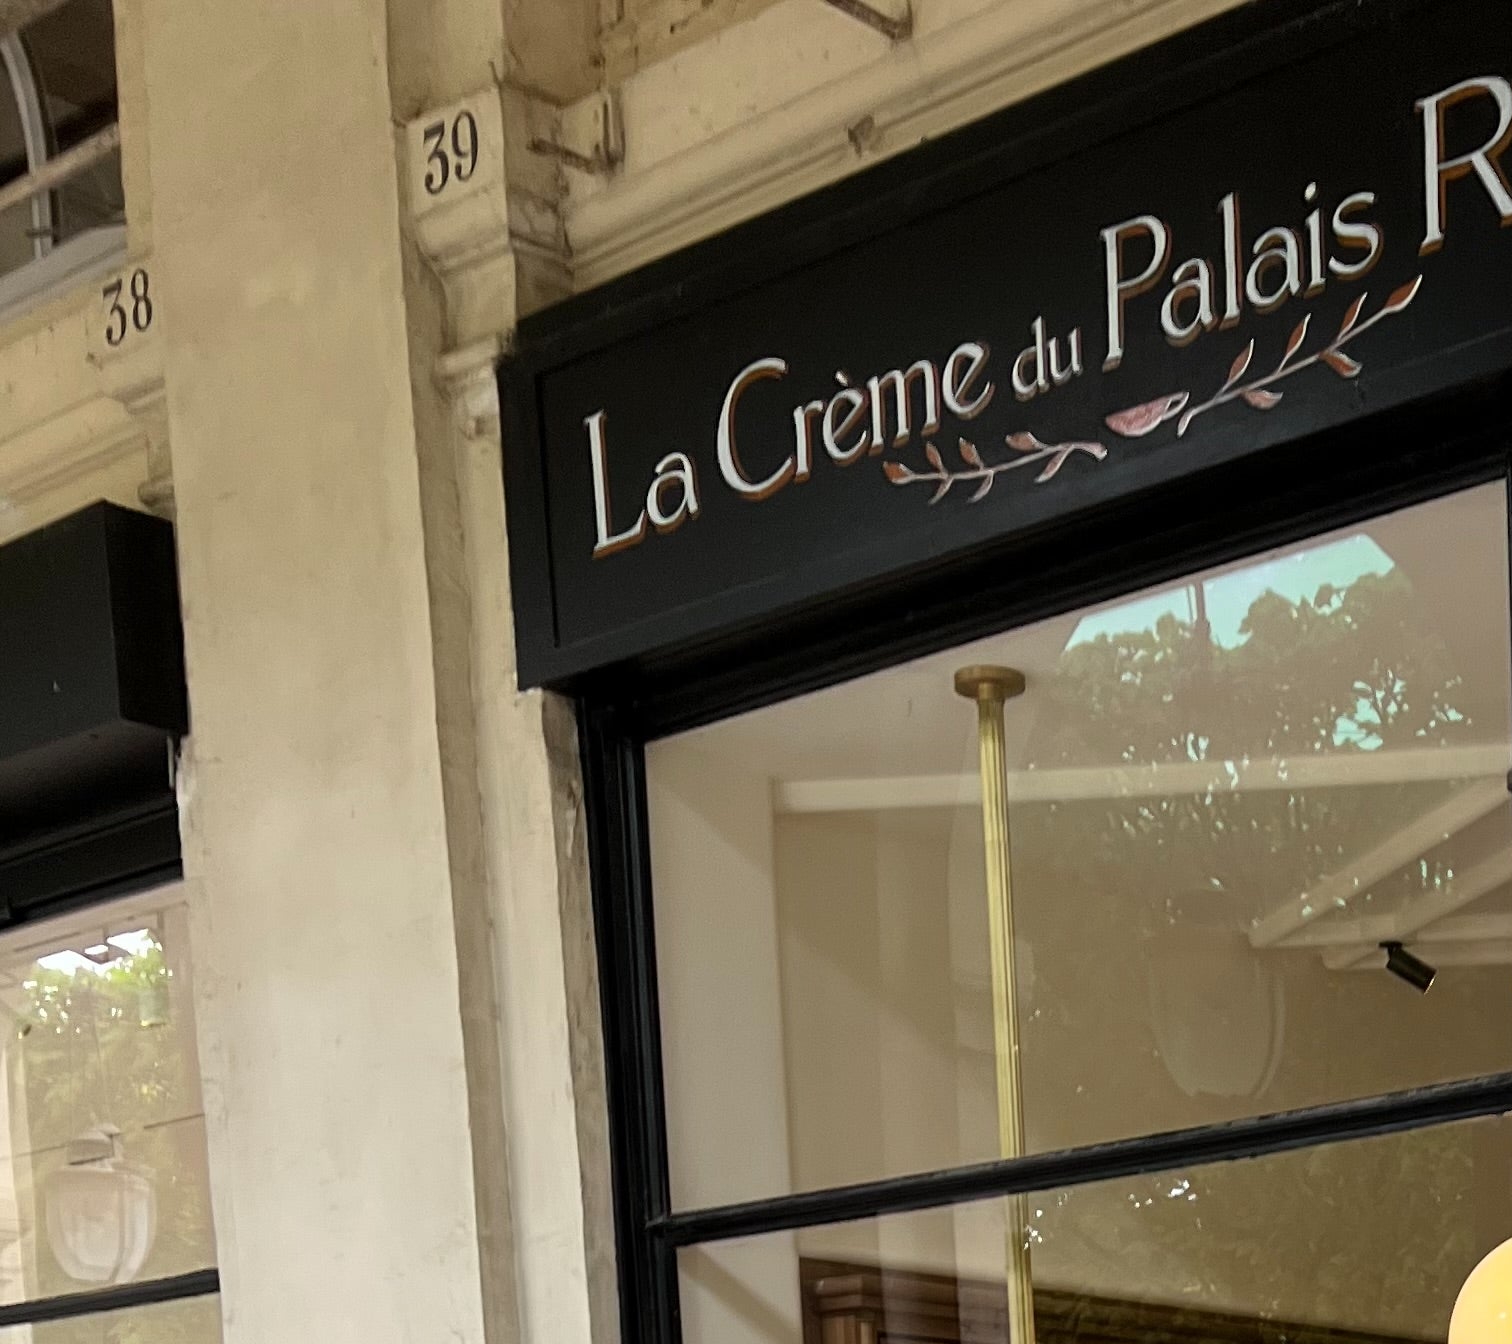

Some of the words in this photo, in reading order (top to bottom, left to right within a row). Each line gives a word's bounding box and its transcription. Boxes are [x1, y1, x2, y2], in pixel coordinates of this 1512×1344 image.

[422, 109, 479, 195] 39
[102, 268, 153, 347] 38
[583, 408, 699, 557] La
[716, 340, 996, 501] Crème
[1010, 314, 1083, 400] du
[1100, 181, 1385, 373] Palais
